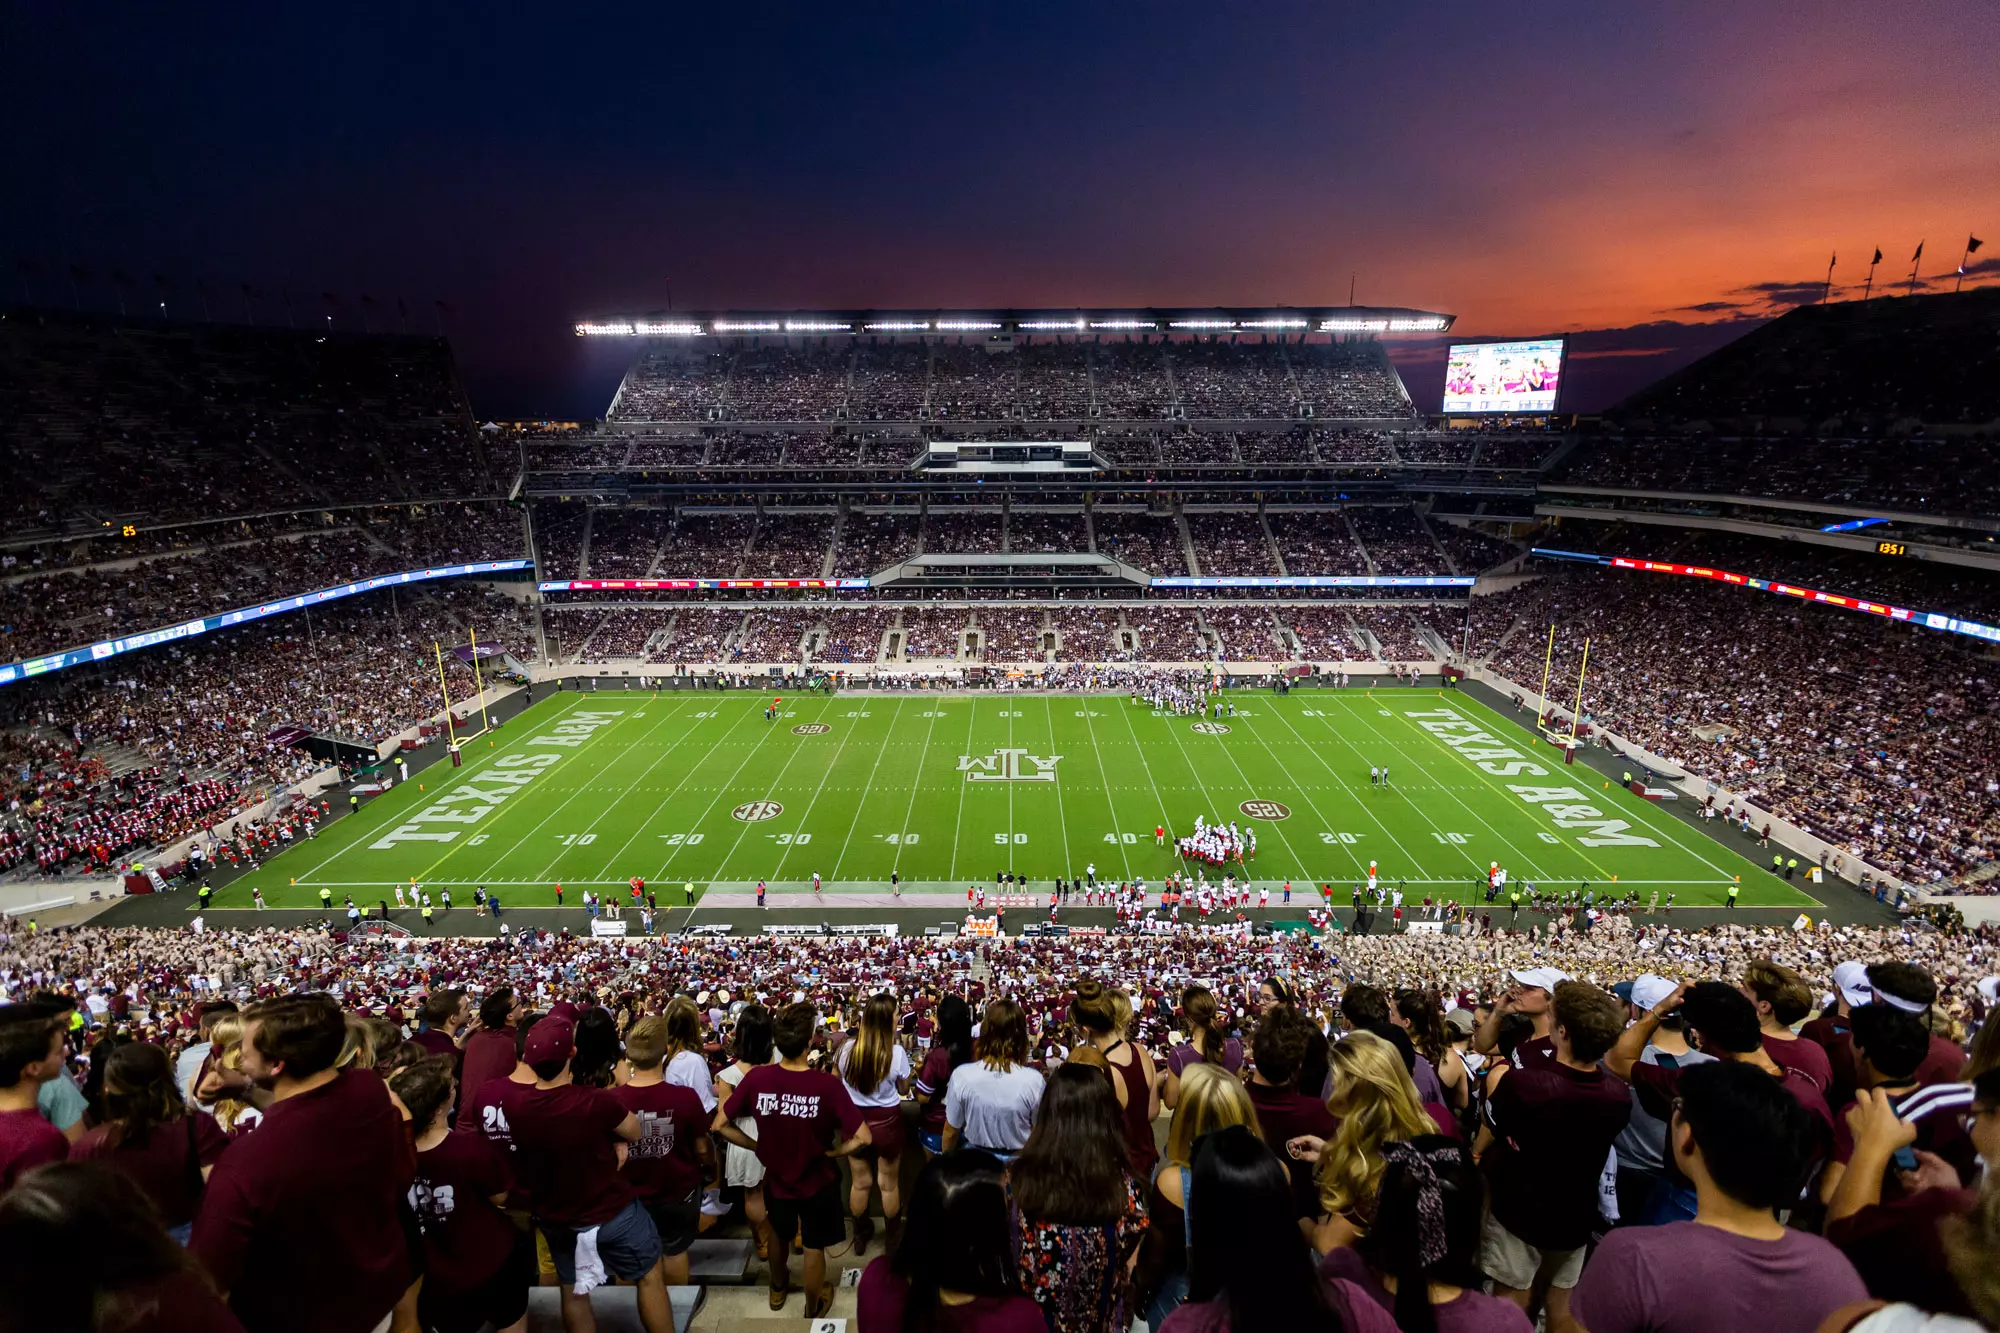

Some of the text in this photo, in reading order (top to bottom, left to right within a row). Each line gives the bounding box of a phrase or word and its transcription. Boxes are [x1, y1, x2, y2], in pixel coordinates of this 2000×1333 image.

[123, 526, 136, 537] 25
[367, 710, 625, 850] TEXAS A&M
[1403, 708, 1663, 848] TEXAS A&M
[735, 801, 781, 821] SEC
[561, 833, 598, 846] 10
[666, 833, 705, 846] 20
[775, 833, 812, 845] 30
[885, 833, 920, 845] 40
[994, 833, 1028, 845] 50
[1103, 832, 1137, 844] 40
[1318, 832, 1359, 845] 20
[1430, 832, 1470, 845] 10
[781, 1093, 820, 1105] CLASS OF
[780, 1101, 819, 1119] 2023
